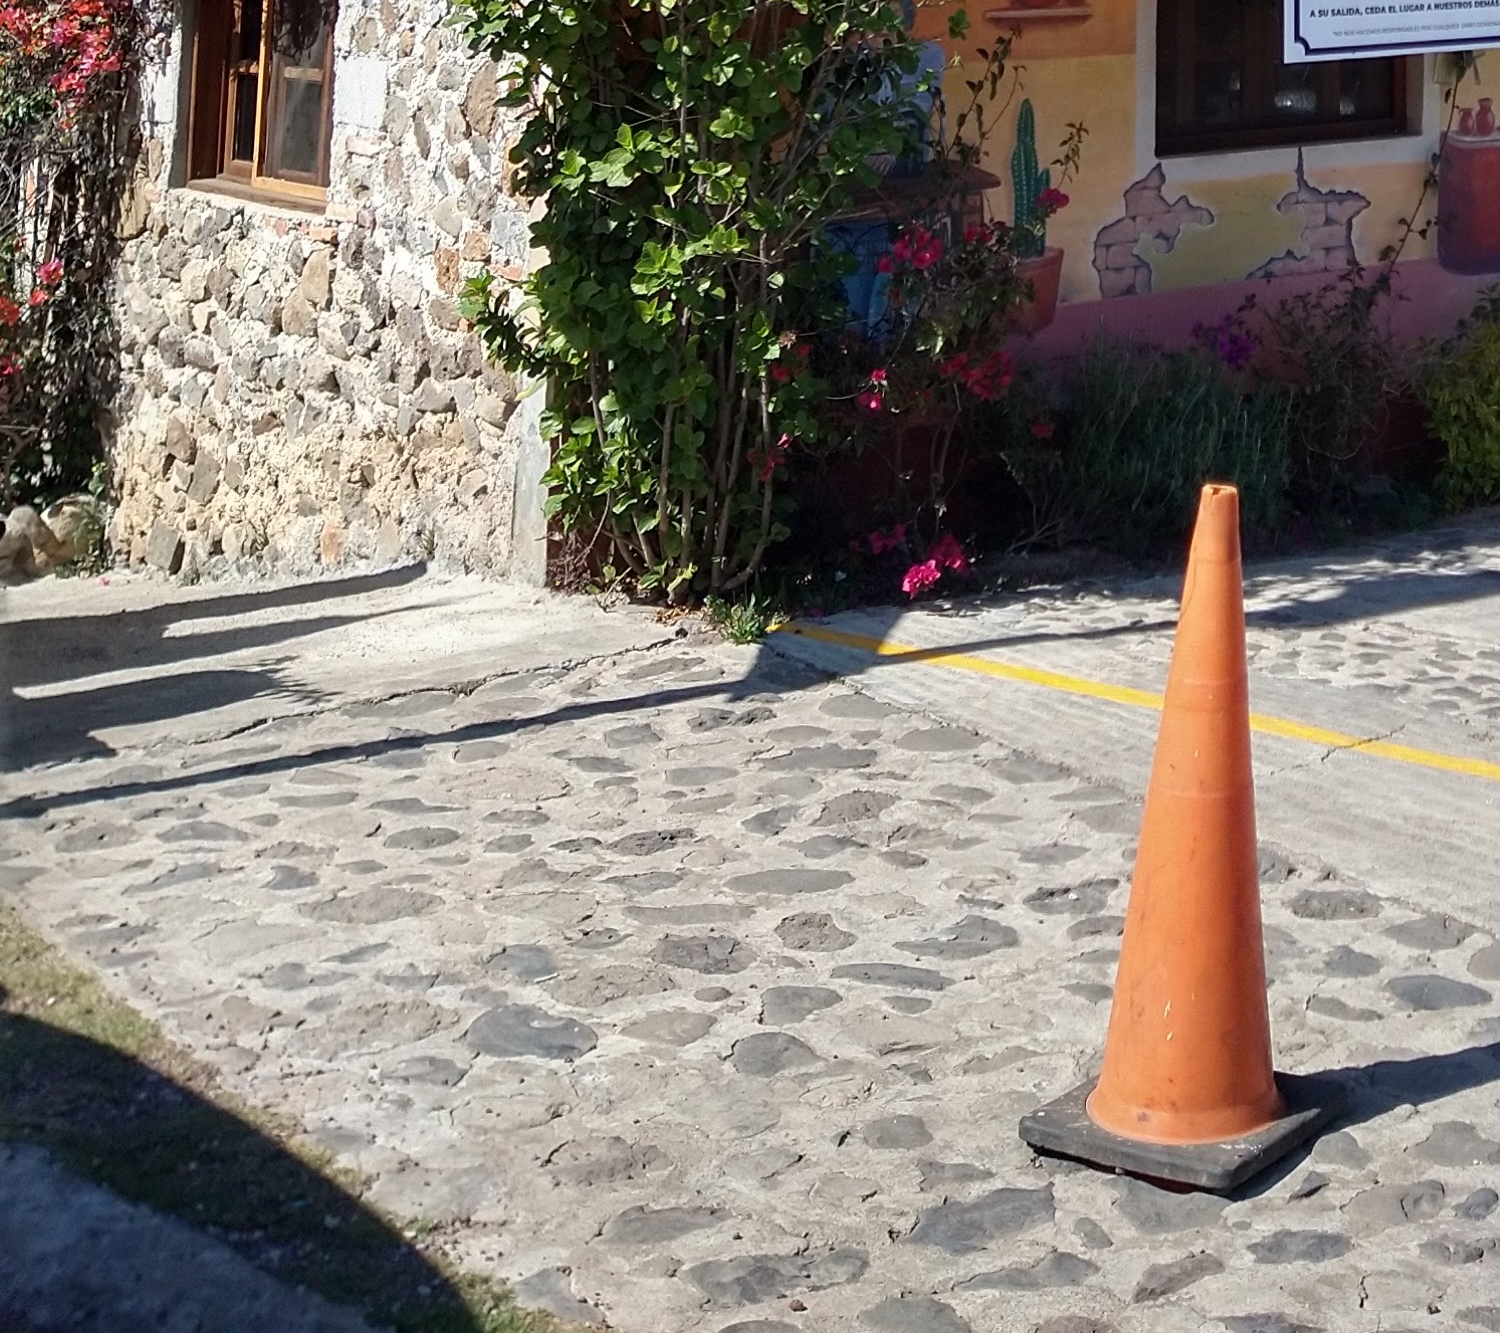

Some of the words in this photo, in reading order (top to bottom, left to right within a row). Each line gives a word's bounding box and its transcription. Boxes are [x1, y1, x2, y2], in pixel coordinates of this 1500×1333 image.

[1309, 9, 1316, 18] A
[1318, 9, 1329, 18] SU
[1330, 8, 1363, 17] SALIDA,
[1364, 6, 1386, 15] CEDA
[1388, 5, 1398, 14] EL
[1399, 4, 1425, 13] LUGAR
[1426, 2, 1433, 11] A
[1434, 0, 1473, 10] NUESTROS
